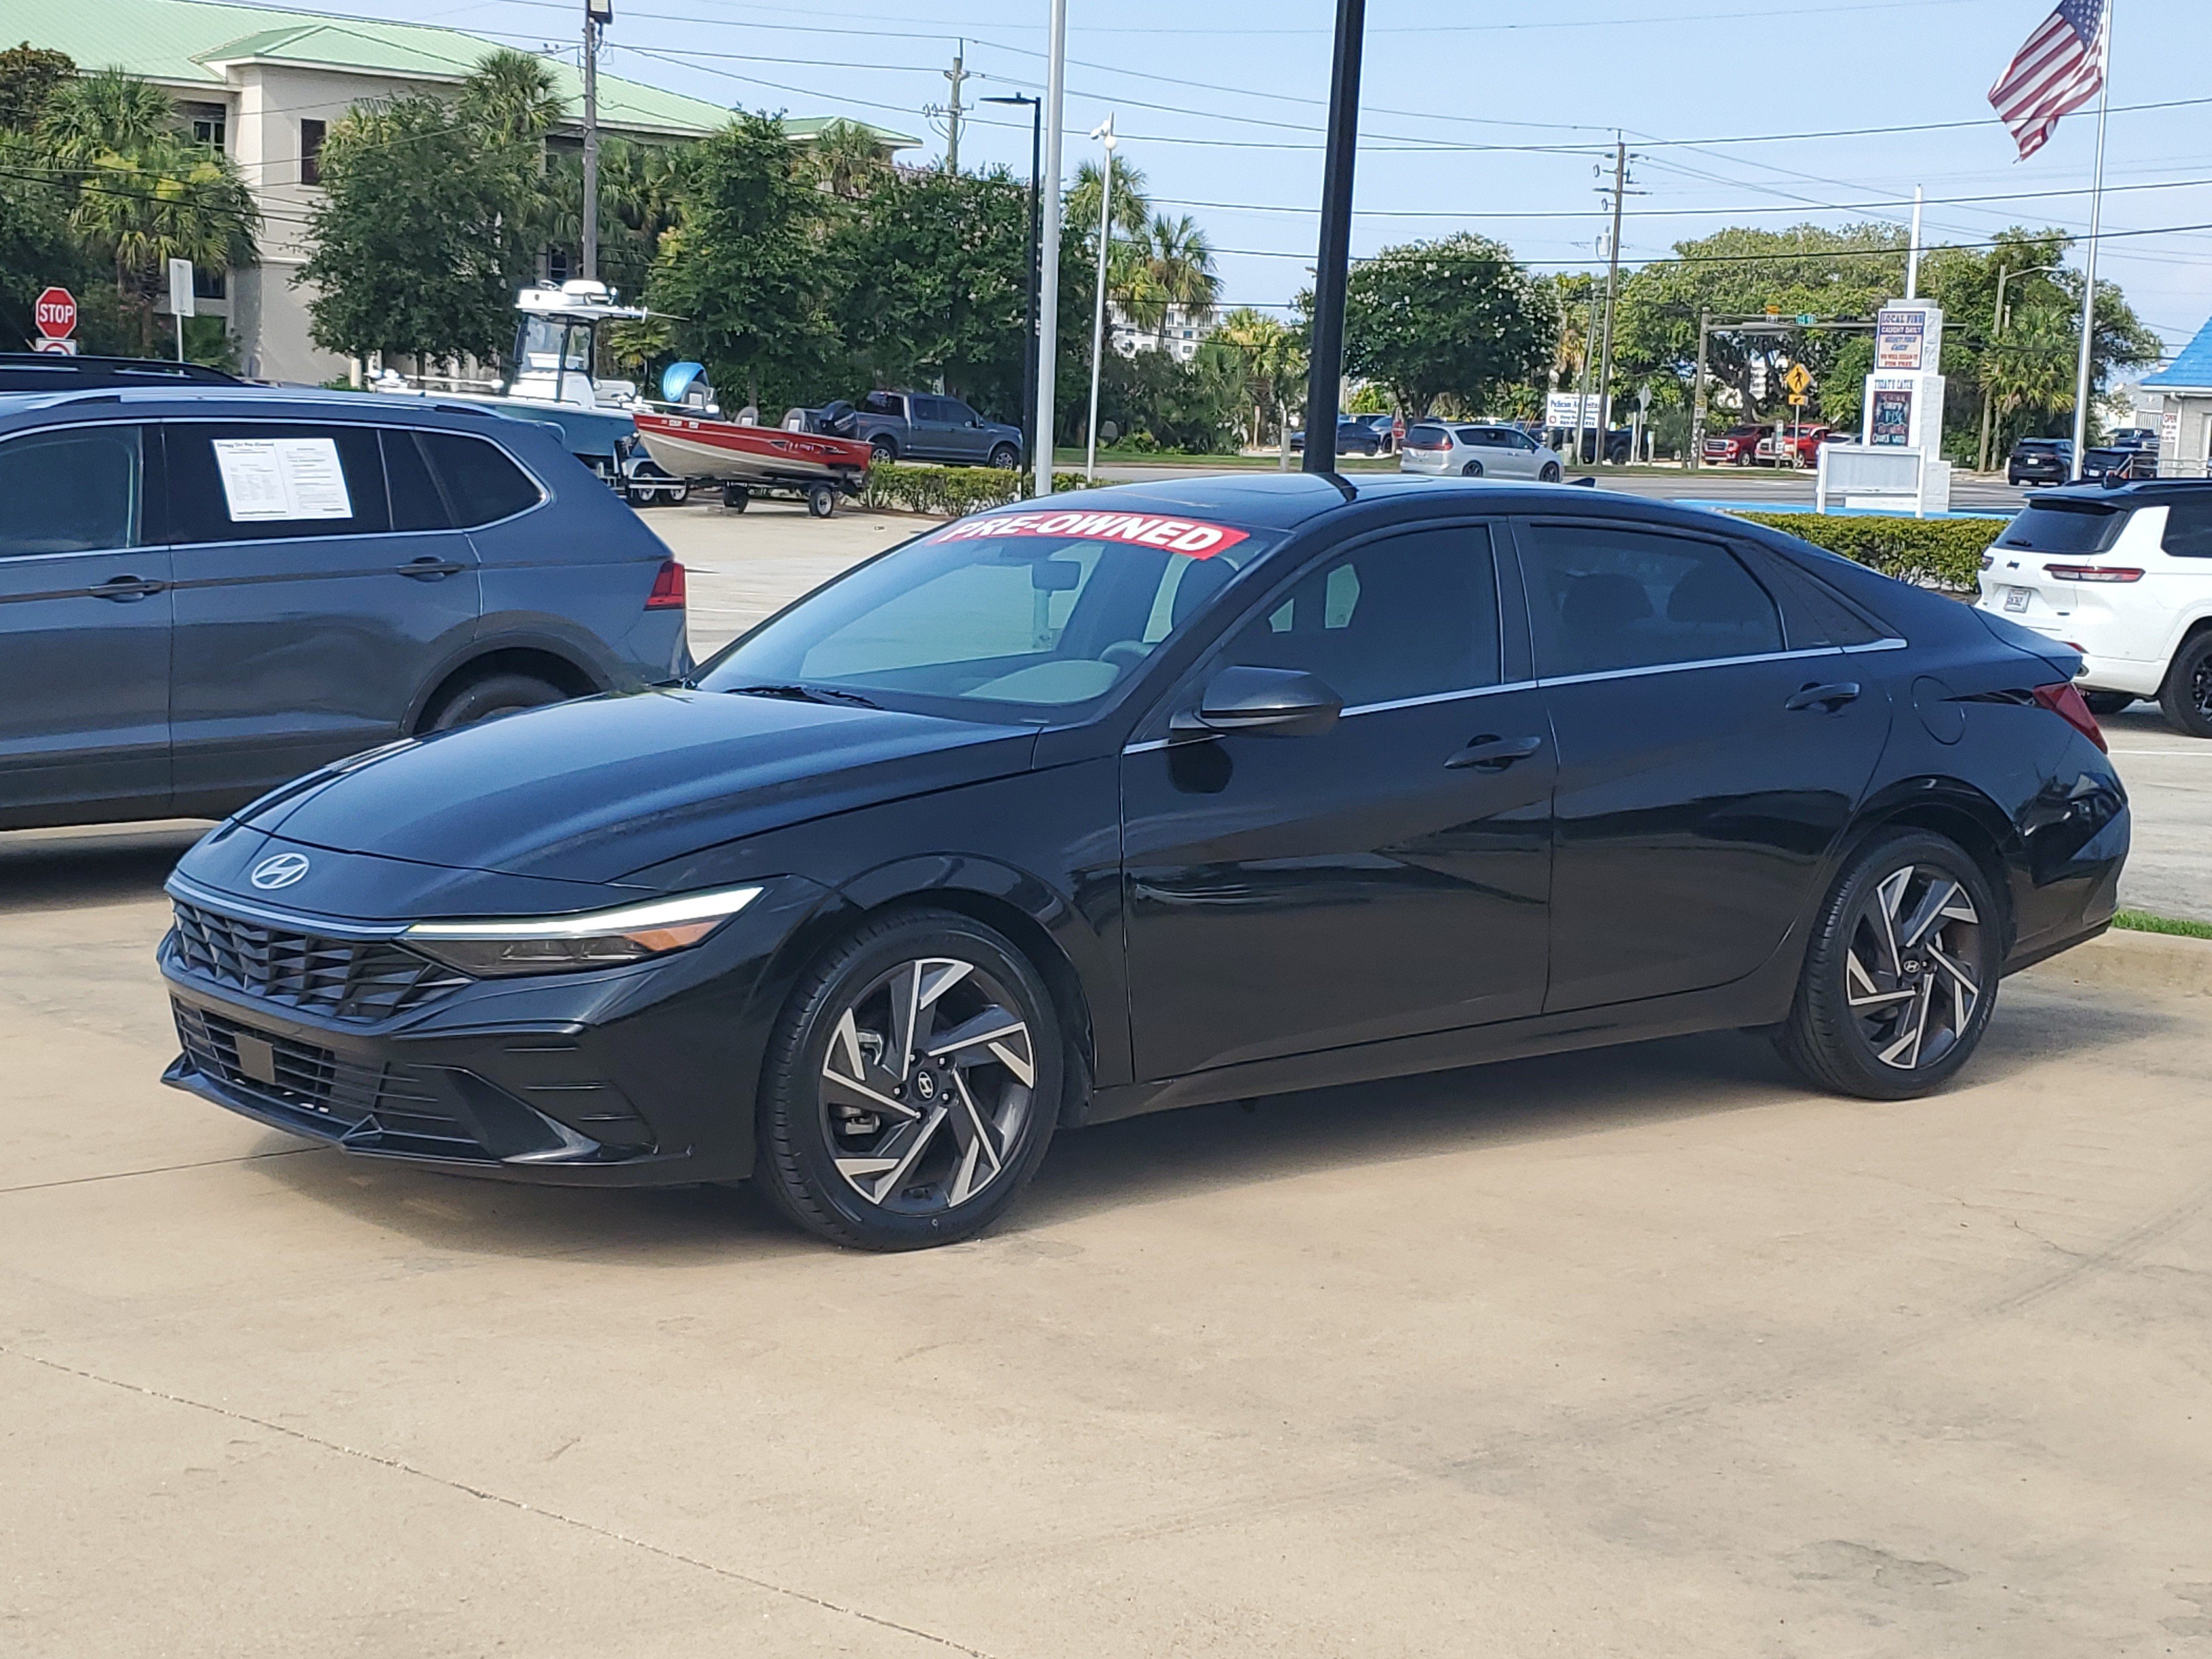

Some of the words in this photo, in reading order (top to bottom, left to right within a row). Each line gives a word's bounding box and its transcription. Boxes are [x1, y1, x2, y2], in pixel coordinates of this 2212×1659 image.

[40, 303, 74, 324] STOP
[1882, 314, 1905, 323] LOCAL
[938, 514, 1223, 552] PRE-OWNED
